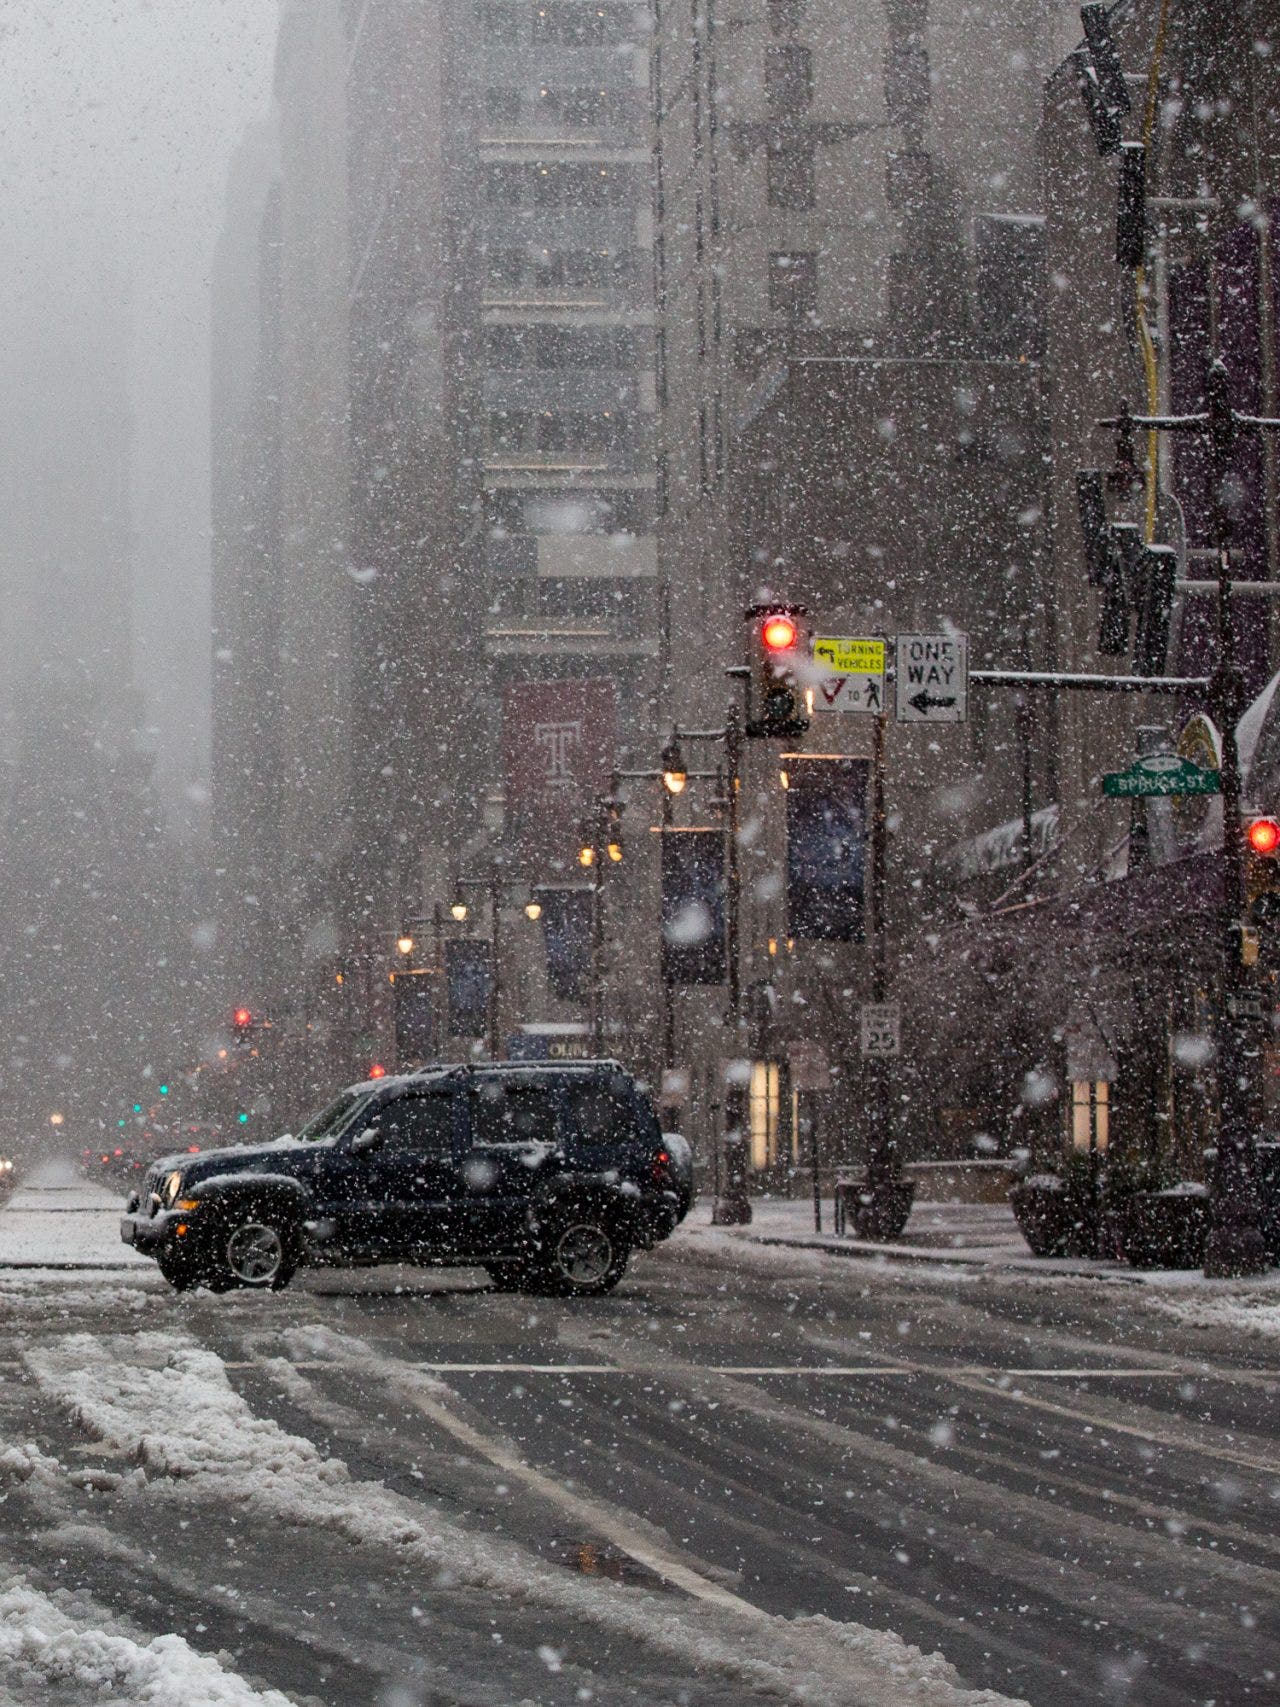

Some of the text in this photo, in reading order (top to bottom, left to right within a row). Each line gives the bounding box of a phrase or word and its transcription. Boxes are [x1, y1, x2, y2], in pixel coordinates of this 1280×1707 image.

[910, 641, 954, 662] ONE
[837, 658, 882, 670] VEHICLES
[907, 665, 955, 685] WAY
[848, 690, 860, 701] TO
[1117, 774, 1206, 794] SPRUCE ST
[866, 1020, 894, 1030] LIM
[867, 1031, 896, 1050] 25
